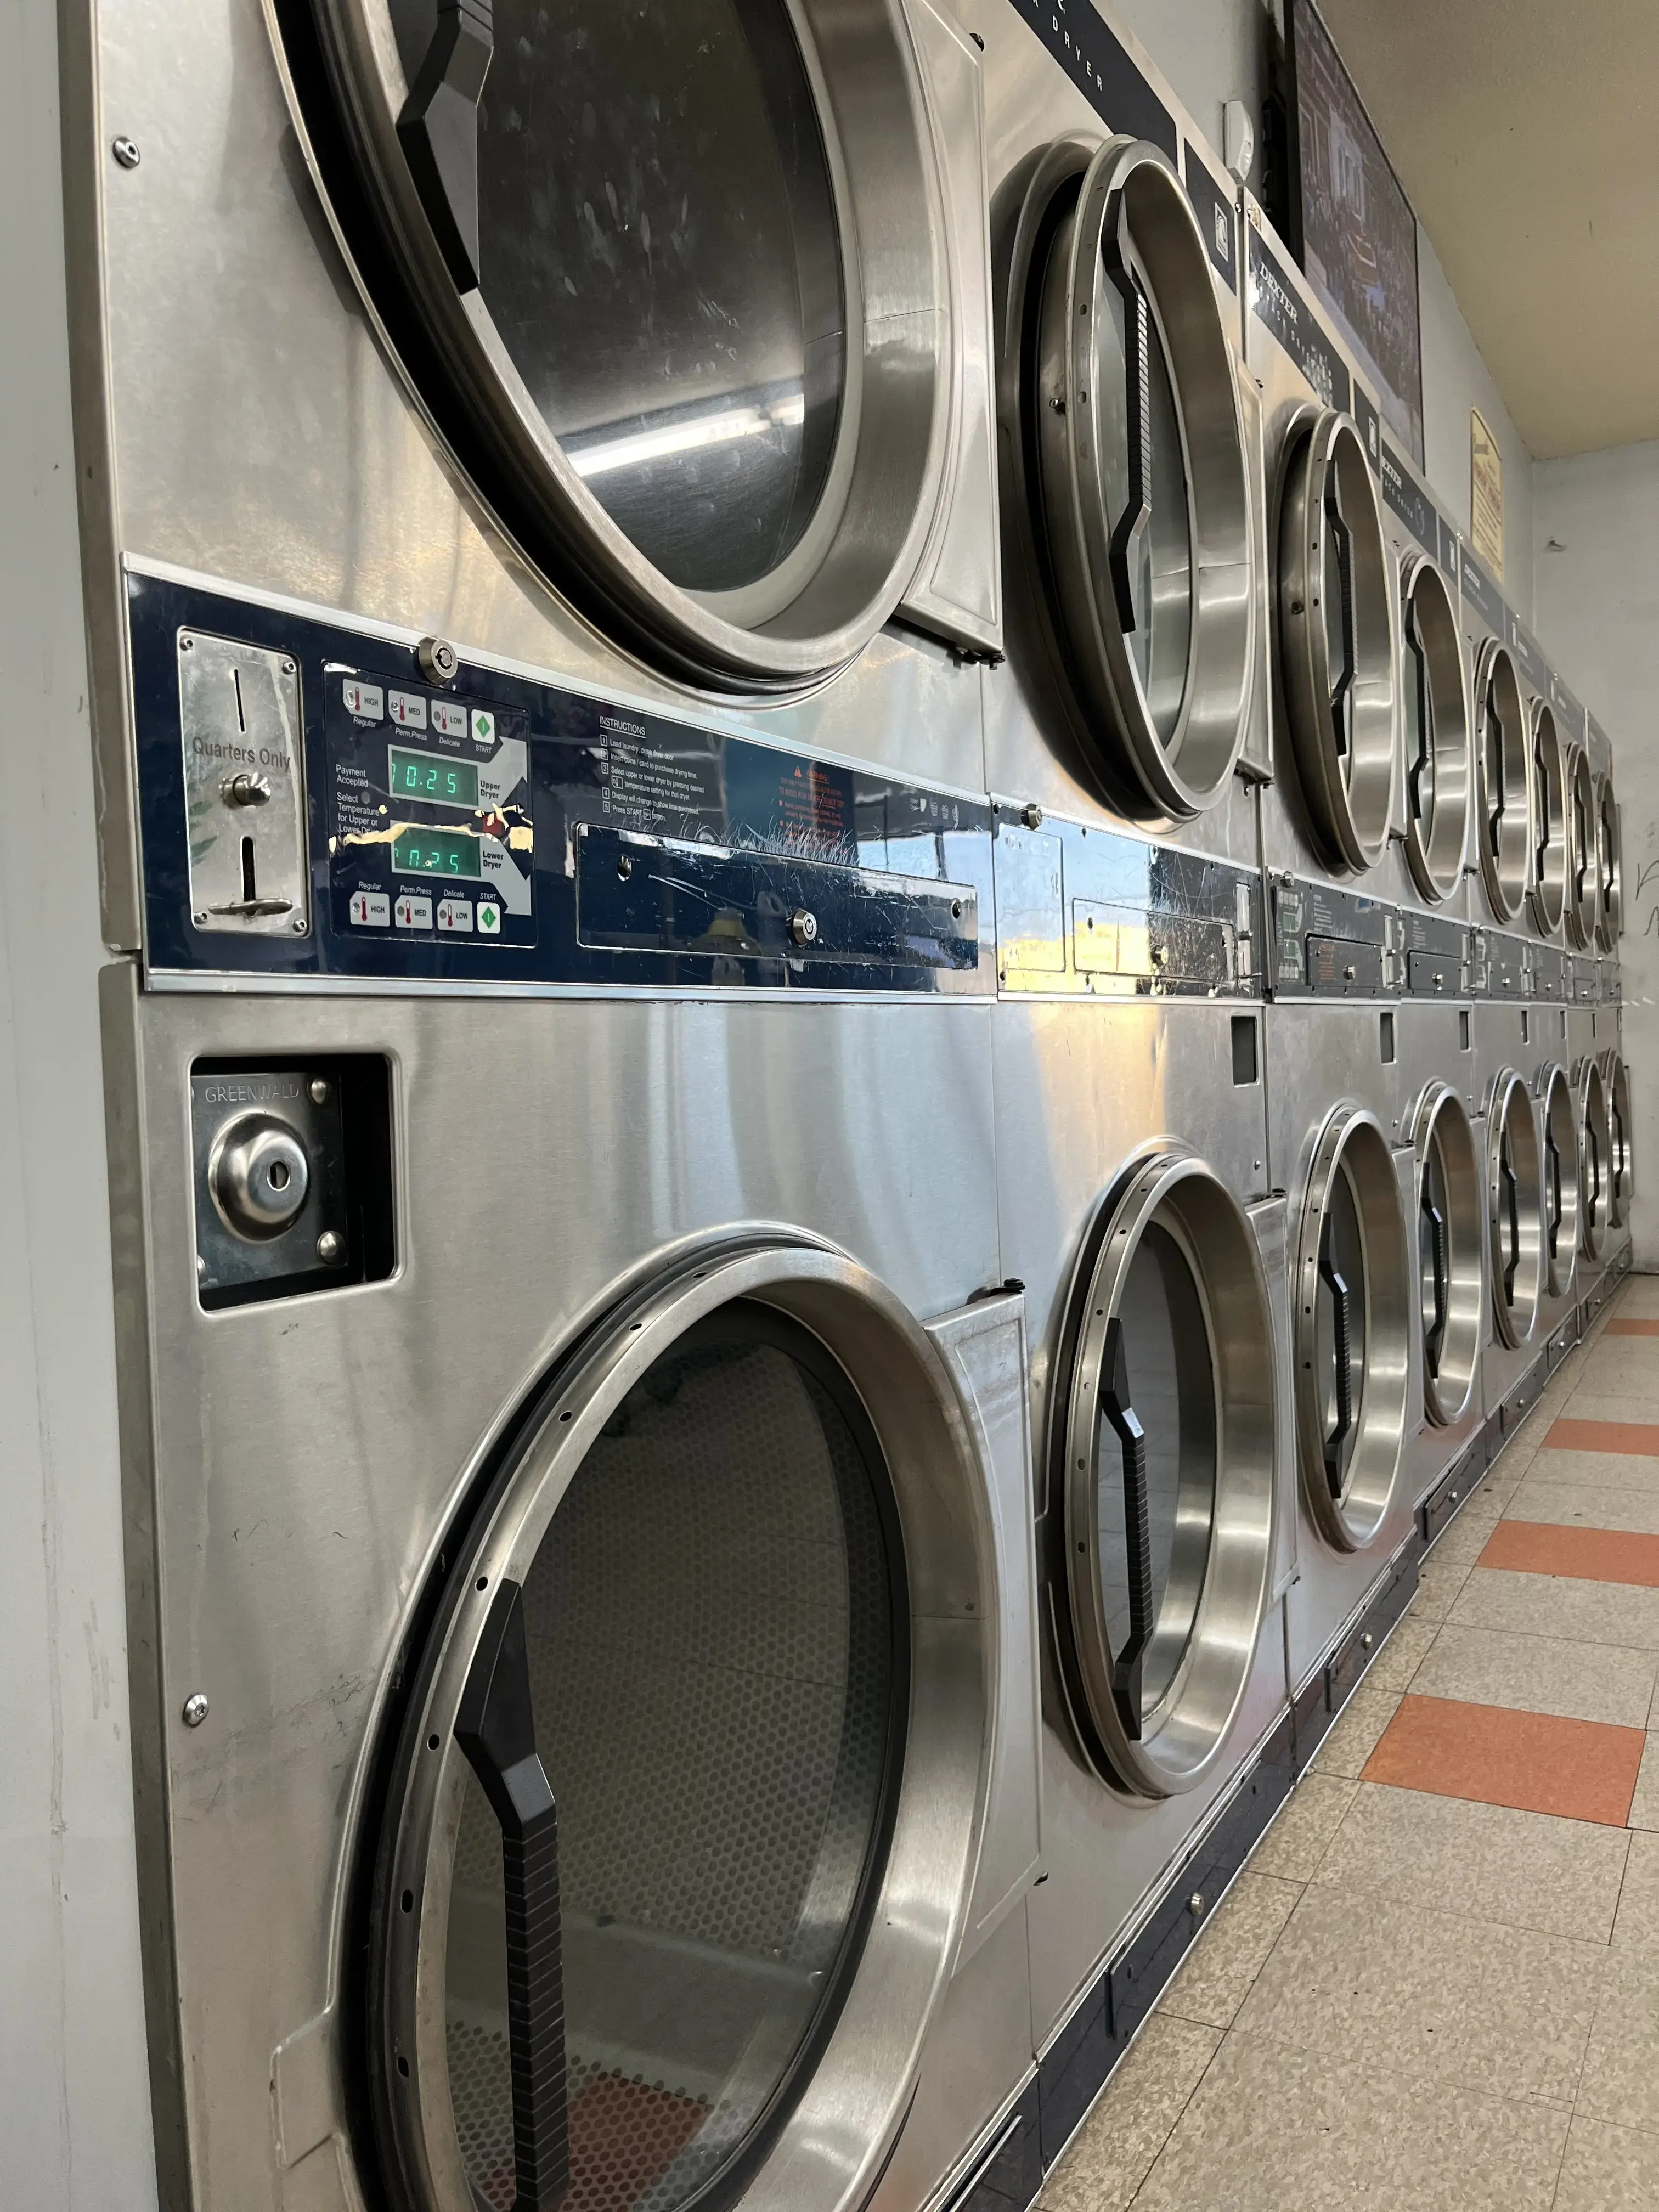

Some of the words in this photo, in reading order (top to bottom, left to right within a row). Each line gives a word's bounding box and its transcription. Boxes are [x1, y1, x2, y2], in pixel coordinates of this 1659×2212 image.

[1052, 15, 1102, 91] DRYER
[1260, 262, 1298, 325] DEXTER
[364, 696, 379, 707] HIGH
[408, 707, 421, 716] MED
[353, 716, 377, 728] Regular
[450, 716, 462, 726] LOW
[599, 715, 646, 736] INSTRUCTIONS
[439, 737, 460, 748] Delicate
[610, 739, 622, 748] Load
[193, 736, 255, 764] Quarters
[259, 748, 290, 772] Only
[475, 744, 493, 754] START
[336, 764, 366, 778] Payment
[639, 760, 649, 769] card
[654, 765, 674, 774] purchase
[675, 768, 687, 778] drying
[336, 775, 369, 788] Accepted
[611, 766, 625, 776] Select
[625, 770, 638, 779] upper
[644, 774, 656, 782] lower
[656, 776, 667, 786] dryer
[667, 779, 672, 787] by
[673, 781, 690, 792] pressing
[690, 783, 704, 793] desired
[480, 780, 500, 791] Upper
[624, 780, 650, 792] temperature
[336, 792, 358, 804] Select
[481, 789, 500, 799] Dryer
[612, 791, 629, 802] Display
[636, 797, 652, 807] change
[669, 803, 678, 811] time
[337, 803, 380, 817] Temperature
[612, 804, 626, 814] Press
[627, 807, 642, 816] START
[337, 812, 347, 822] for
[349, 814, 370, 826] Upper
[483, 850, 504, 861] Lower
[483, 859, 502, 870] Dryer
[358, 881, 382, 891] Regular
[443, 889, 465, 899] Delicate
[479, 893, 496, 901] START
[371, 906, 385, 914] HIGH
[414, 909, 426, 917] MED
[455, 912, 468, 920] LOW
[205, 1083, 300, 1103] GREENWALD
